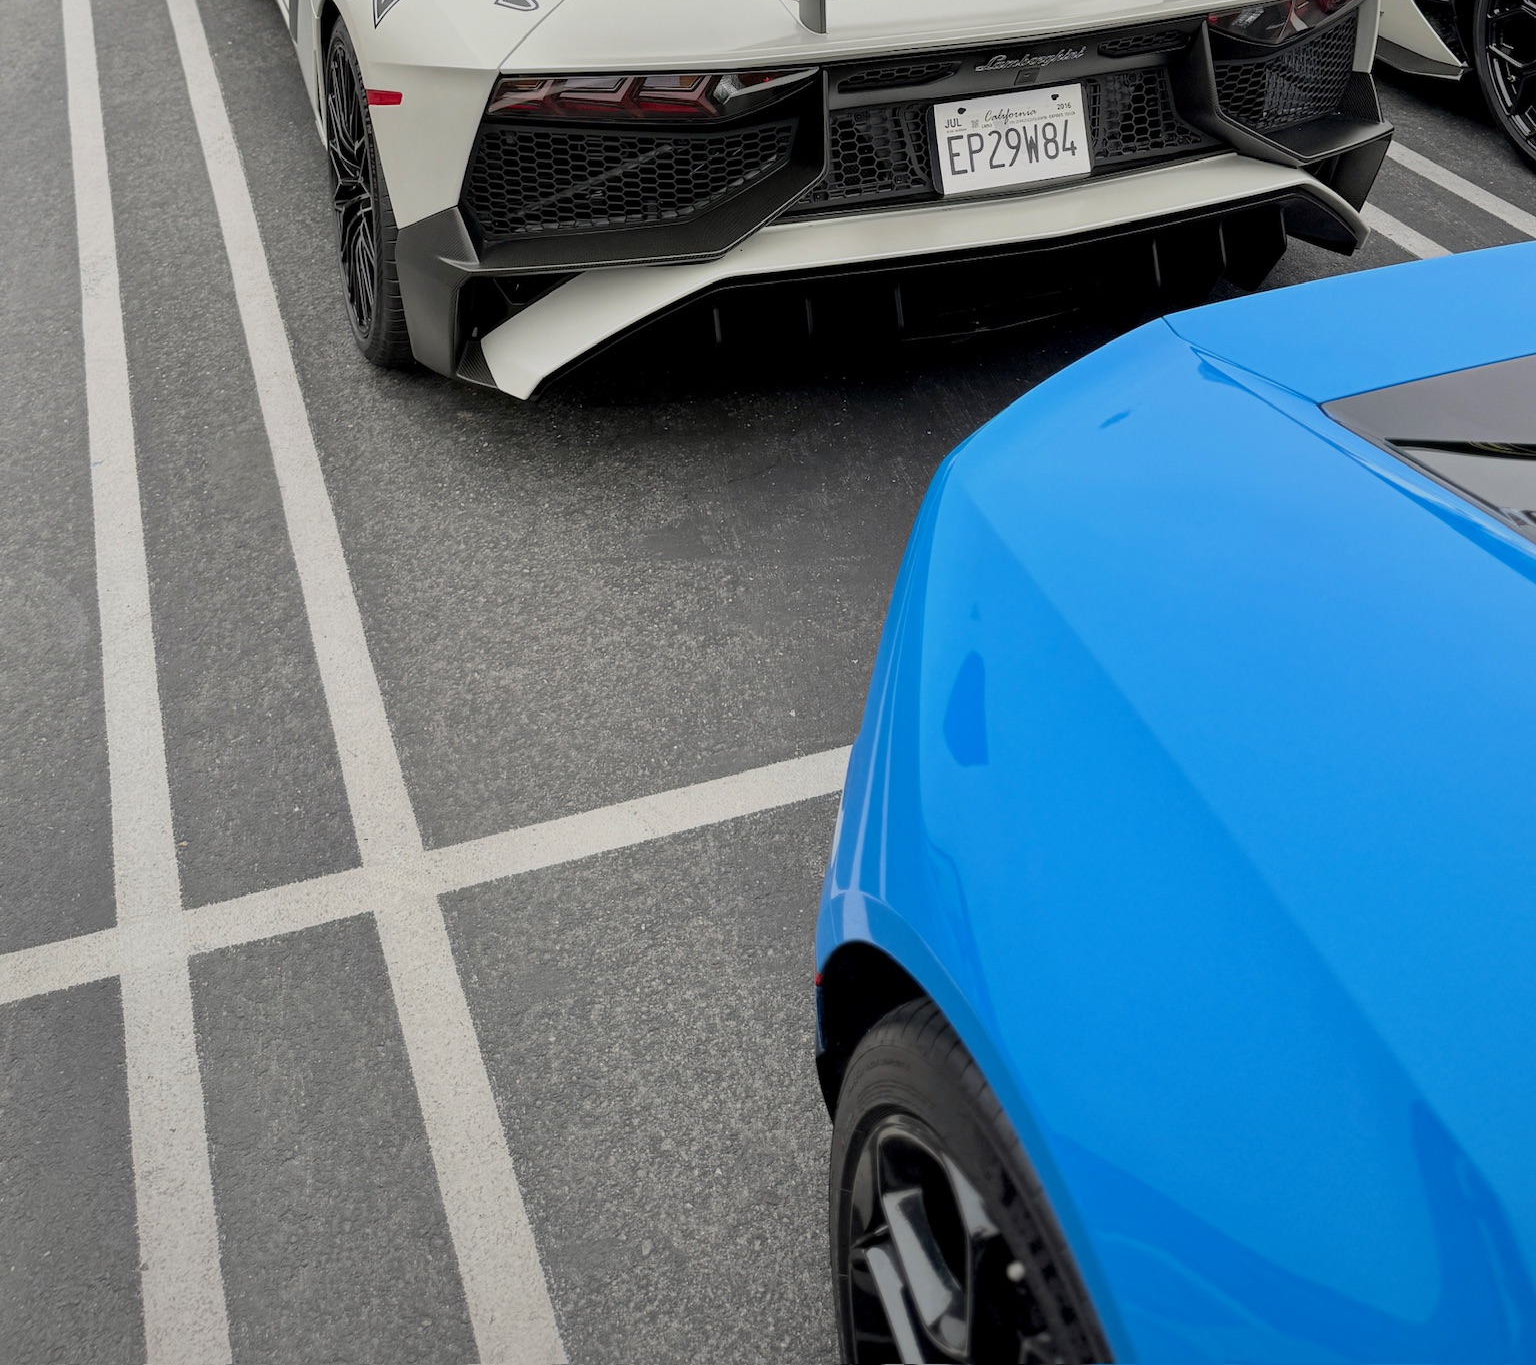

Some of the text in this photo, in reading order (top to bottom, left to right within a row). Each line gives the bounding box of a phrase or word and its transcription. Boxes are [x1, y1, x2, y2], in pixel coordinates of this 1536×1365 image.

[975, 46, 1087, 72] Lamborghini
[944, 118, 962, 129] JUL
[984, 108, 1038, 125] California
[946, 119, 1078, 176] EP29W84
